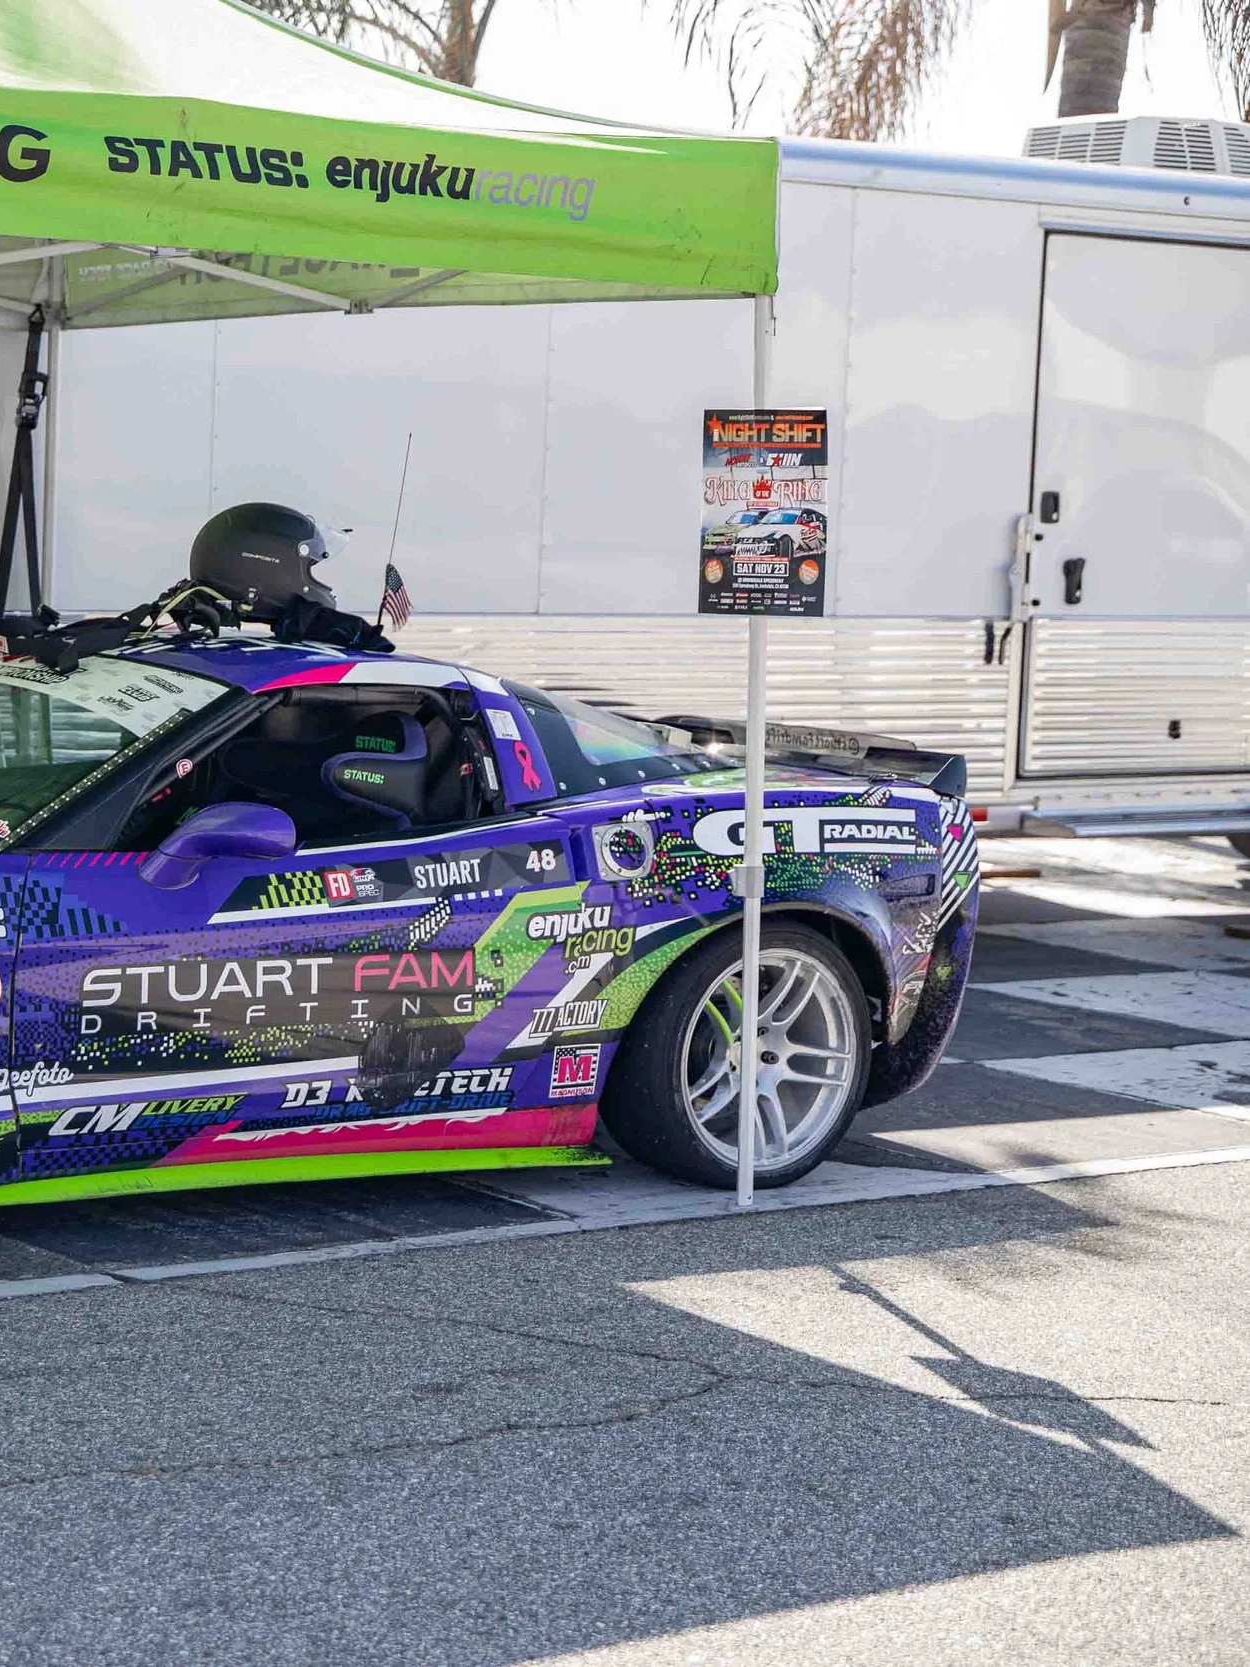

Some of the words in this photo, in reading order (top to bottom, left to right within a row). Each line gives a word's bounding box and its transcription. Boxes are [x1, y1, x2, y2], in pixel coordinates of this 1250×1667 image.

[104, 134, 308, 190] STATUS:
[718, 422, 770, 443] NIGHT
[772, 422, 826, 443] SHIFT
[736, 563, 754, 574] SAT
[755, 563, 773, 574] NOV
[774, 563, 785, 574] 23
[355, 735, 396, 753] STATUS:
[343, 769, 385, 784] STATUS:
[693, 806, 916, 857] GT
[823, 823, 916, 840] RADIAL
[525, 848, 557, 873] 48
[328, 872, 351, 897] FD
[414, 858, 481, 889] STUART
[356, 884, 374, 892] PRO
[358, 889, 380, 898] SPEC
[527, 903, 611, 942] enjuku
[564, 954, 592, 974] .cm
[82, 956, 334, 1007] STUART
[354, 950, 475, 993] FAM
[80, 993, 474, 1035] DRIFTING
[555, 999, 608, 1028] ACTORY
[556, 1054, 593, 1084] M
[281, 1080, 332, 1109] D3
[550, 1087, 594, 1097] MAGNUSON
[49, 1102, 150, 1137] CM
[144, 1094, 244, 1115] LIVERY
[136, 1109, 234, 1130] DESIGN
